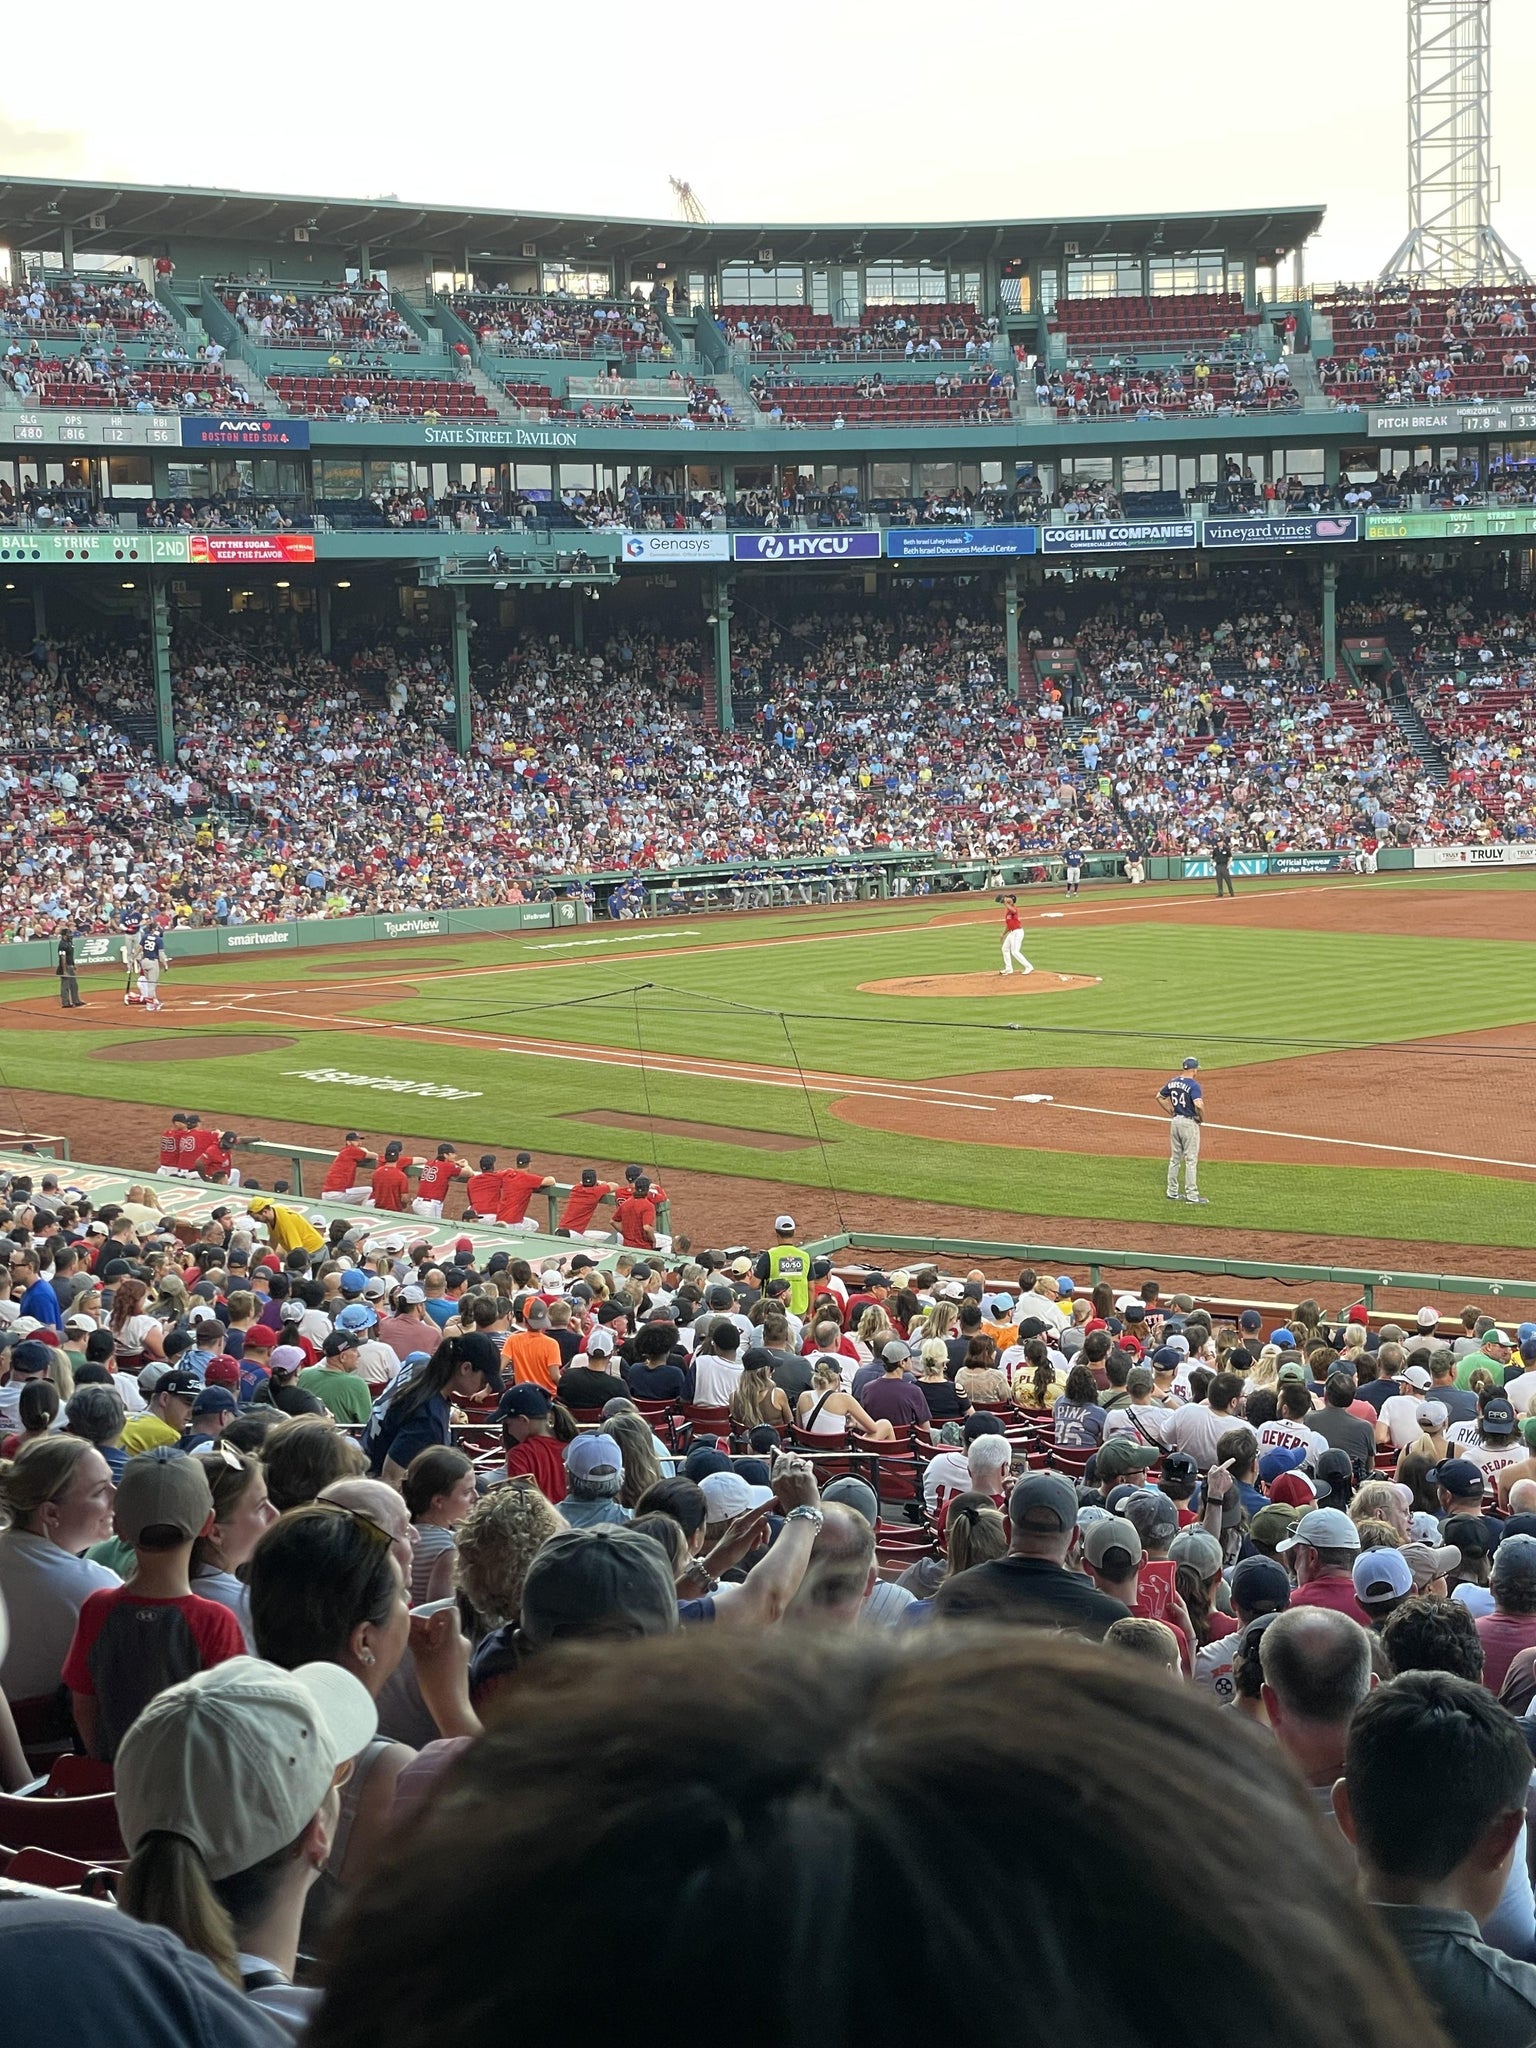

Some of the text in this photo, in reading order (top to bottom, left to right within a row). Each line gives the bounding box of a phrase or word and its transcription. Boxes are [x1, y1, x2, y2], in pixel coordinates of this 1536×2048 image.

[1457, 407, 1501, 415] HORIZONTAL
[1510, 405, 1536, 414] VERTIC
[20, 415, 37, 424] SLG
[65, 416, 82, 425] OPS
[111, 417, 122, 426] HR
[153, 418, 168, 427] RBI
[1377, 416, 1448, 429] PITCH BREAK
[1466, 418, 1507, 430] 17.8 IN
[16, 428, 43, 440] .480
[63, 428, 86, 440] .816
[112, 430, 124, 441] 12
[154, 430, 168, 441] 56
[201, 432, 279, 443] BOSTON RED SOX
[424, 427, 464, 443] STATE
[516, 429, 577, 446] PAVILION
[1369, 516, 1402, 524] PITCHING
[1450, 513, 1473, 521] TOTAL
[1487, 511, 1516, 520] STRIKES
[1369, 526, 1407, 538] BELLO
[1453, 523, 1467, 534] 27
[1494, 521, 1506, 532] 17
[1045, 525, 1194, 542] COGHLIN COMPANIES
[1209, 524, 1272, 541] vineyard
[1273, 525, 1312, 536] vines
[2, 536, 39, 548] BALL
[54, 537, 100, 548] STRIKE
[113, 537, 139, 548] OUT
[210, 541, 227, 549] CUT
[228, 541, 244, 549] THE
[650, 537, 711, 552] Genasys
[788, 537, 849, 555] HYCU
[156, 541, 185, 556] 2ND
[903, 544, 1017, 555] Beth Israel Deaconess Medical Center
[218, 551, 283, 559] KEEP THE FLAVOR
[1470, 849, 1504, 860] TRULY
[1302, 858, 1331, 867] Eyewear
[523, 912, 550, 921] LifeBrand
[384, 919, 440, 938] TouchView
[227, 931, 289, 946] smartwater
[1170, 1090, 1187, 1108] 64
[781, 1261, 802, 1269] 50/50
[1057, 1404, 1092, 1423] PINK
[1488, 1410, 1508, 1419] PFG
[1262, 1429, 1310, 1450] DEVERS
[1457, 1428, 1482, 1447] RYAN
